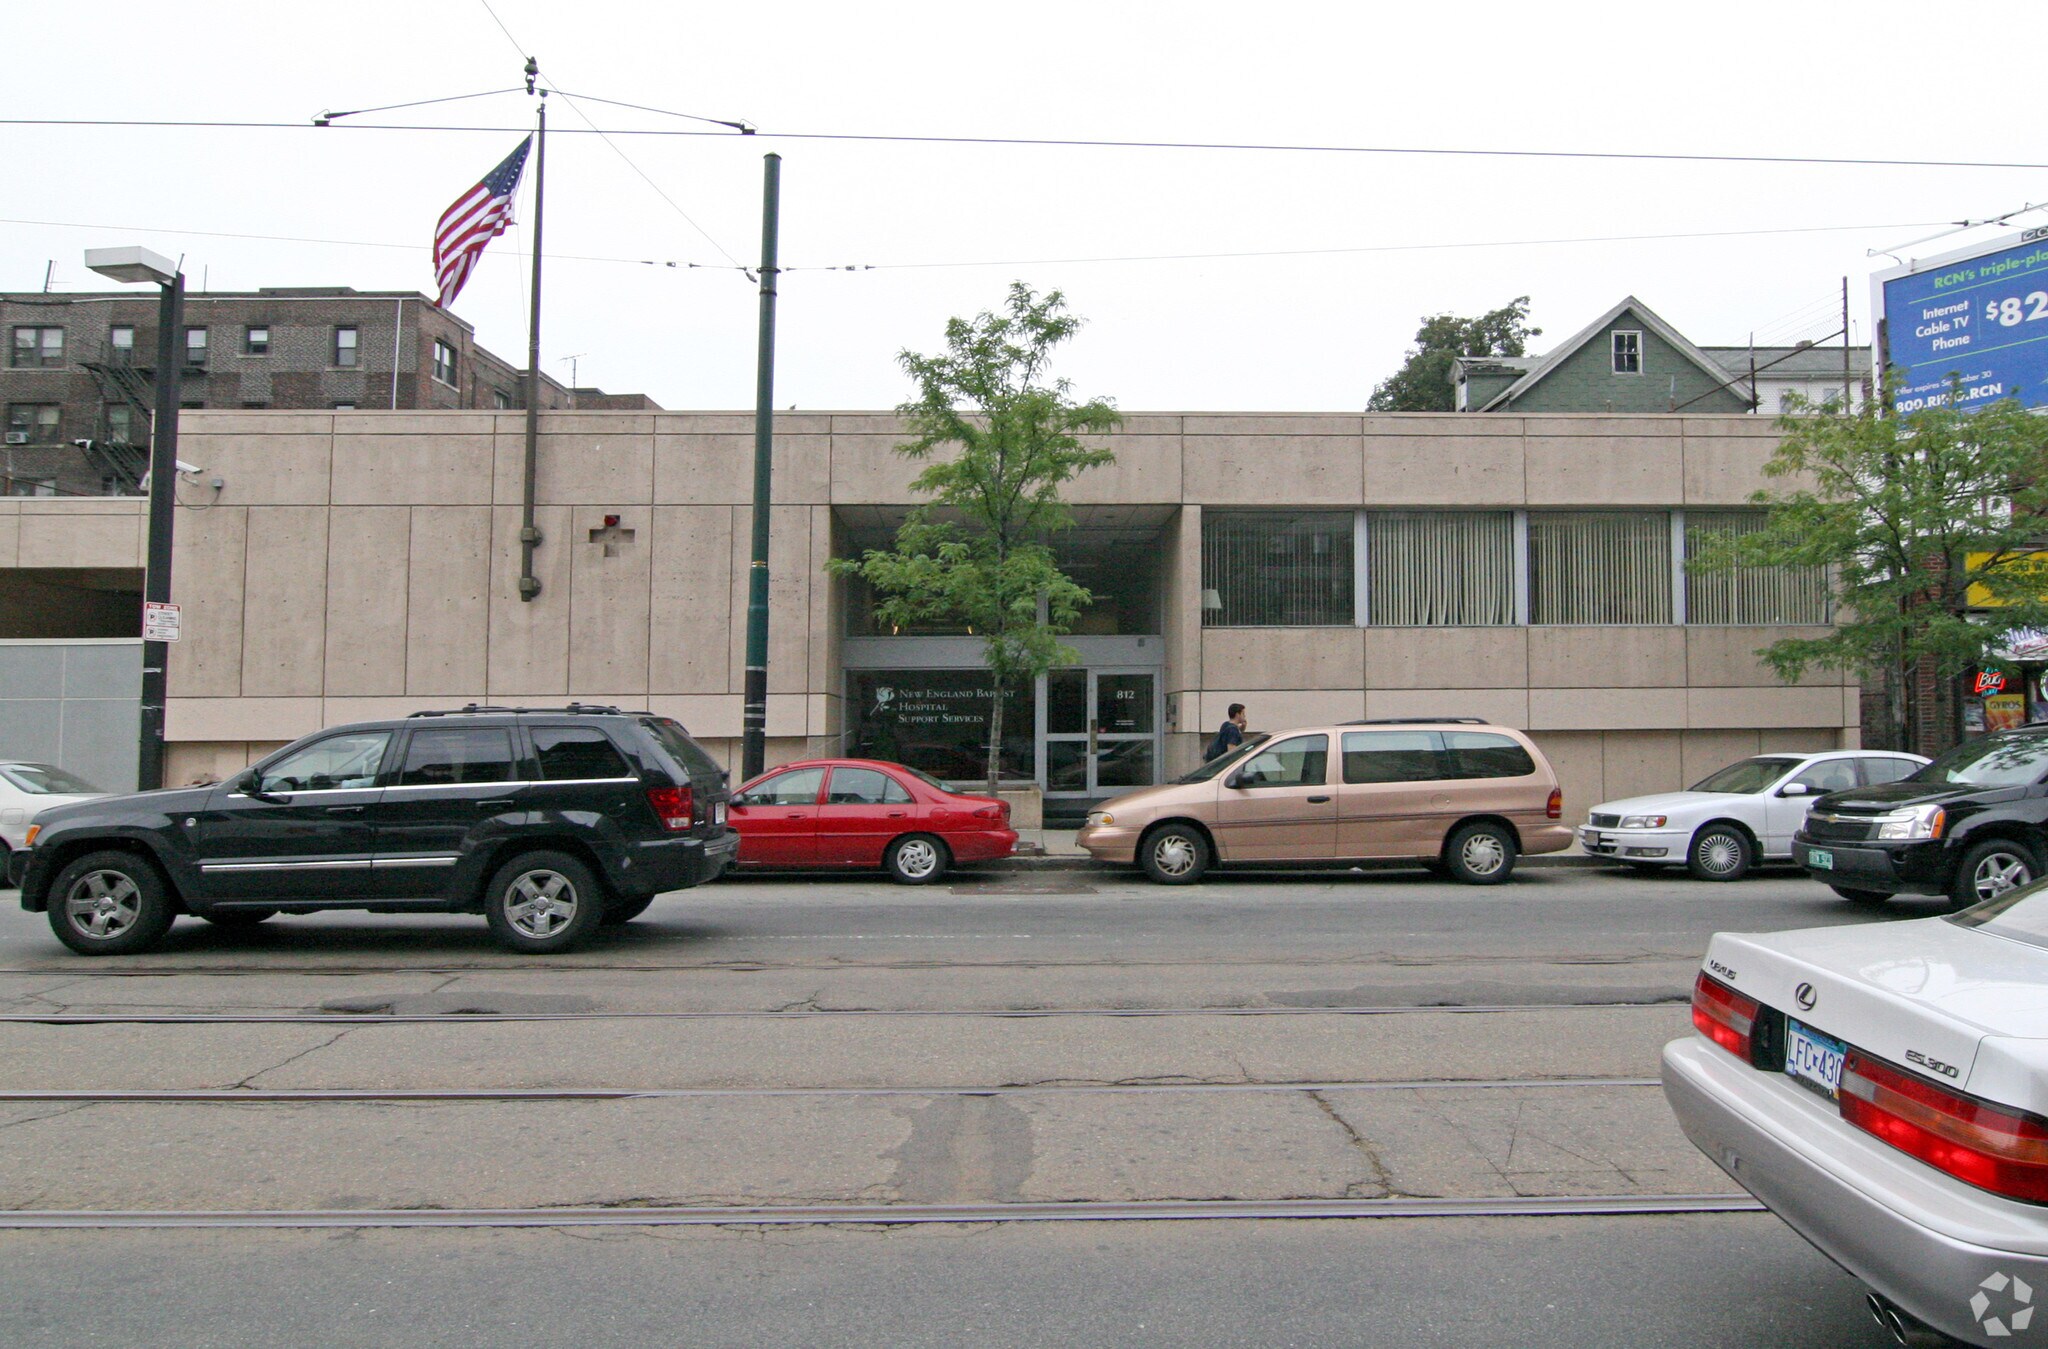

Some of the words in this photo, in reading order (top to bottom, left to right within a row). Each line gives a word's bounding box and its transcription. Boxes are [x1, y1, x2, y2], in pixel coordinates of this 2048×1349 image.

[1934, 270, 1976, 288] RCN's
[1923, 300, 1969, 320] Internet
[1986, 291, 2048, 327] $82
[1915, 321, 1951, 338] Cable
[1953, 315, 1970, 329] TV
[1932, 335, 1970, 351] Phone
[1914, 383, 1940, 392] expires
[1981, 370, 1992, 379] 30
[926, 689, 974, 698] ENGLAND
[976, 688, 1015, 698] BAPST
[1116, 690, 1135, 699] 812
[899, 702, 948, 711] HOSPITAL
[1990, 700, 2021, 709] GYROS
[898, 713, 939, 723] SUPPORT
[942, 713, 984, 723] SERVICES
